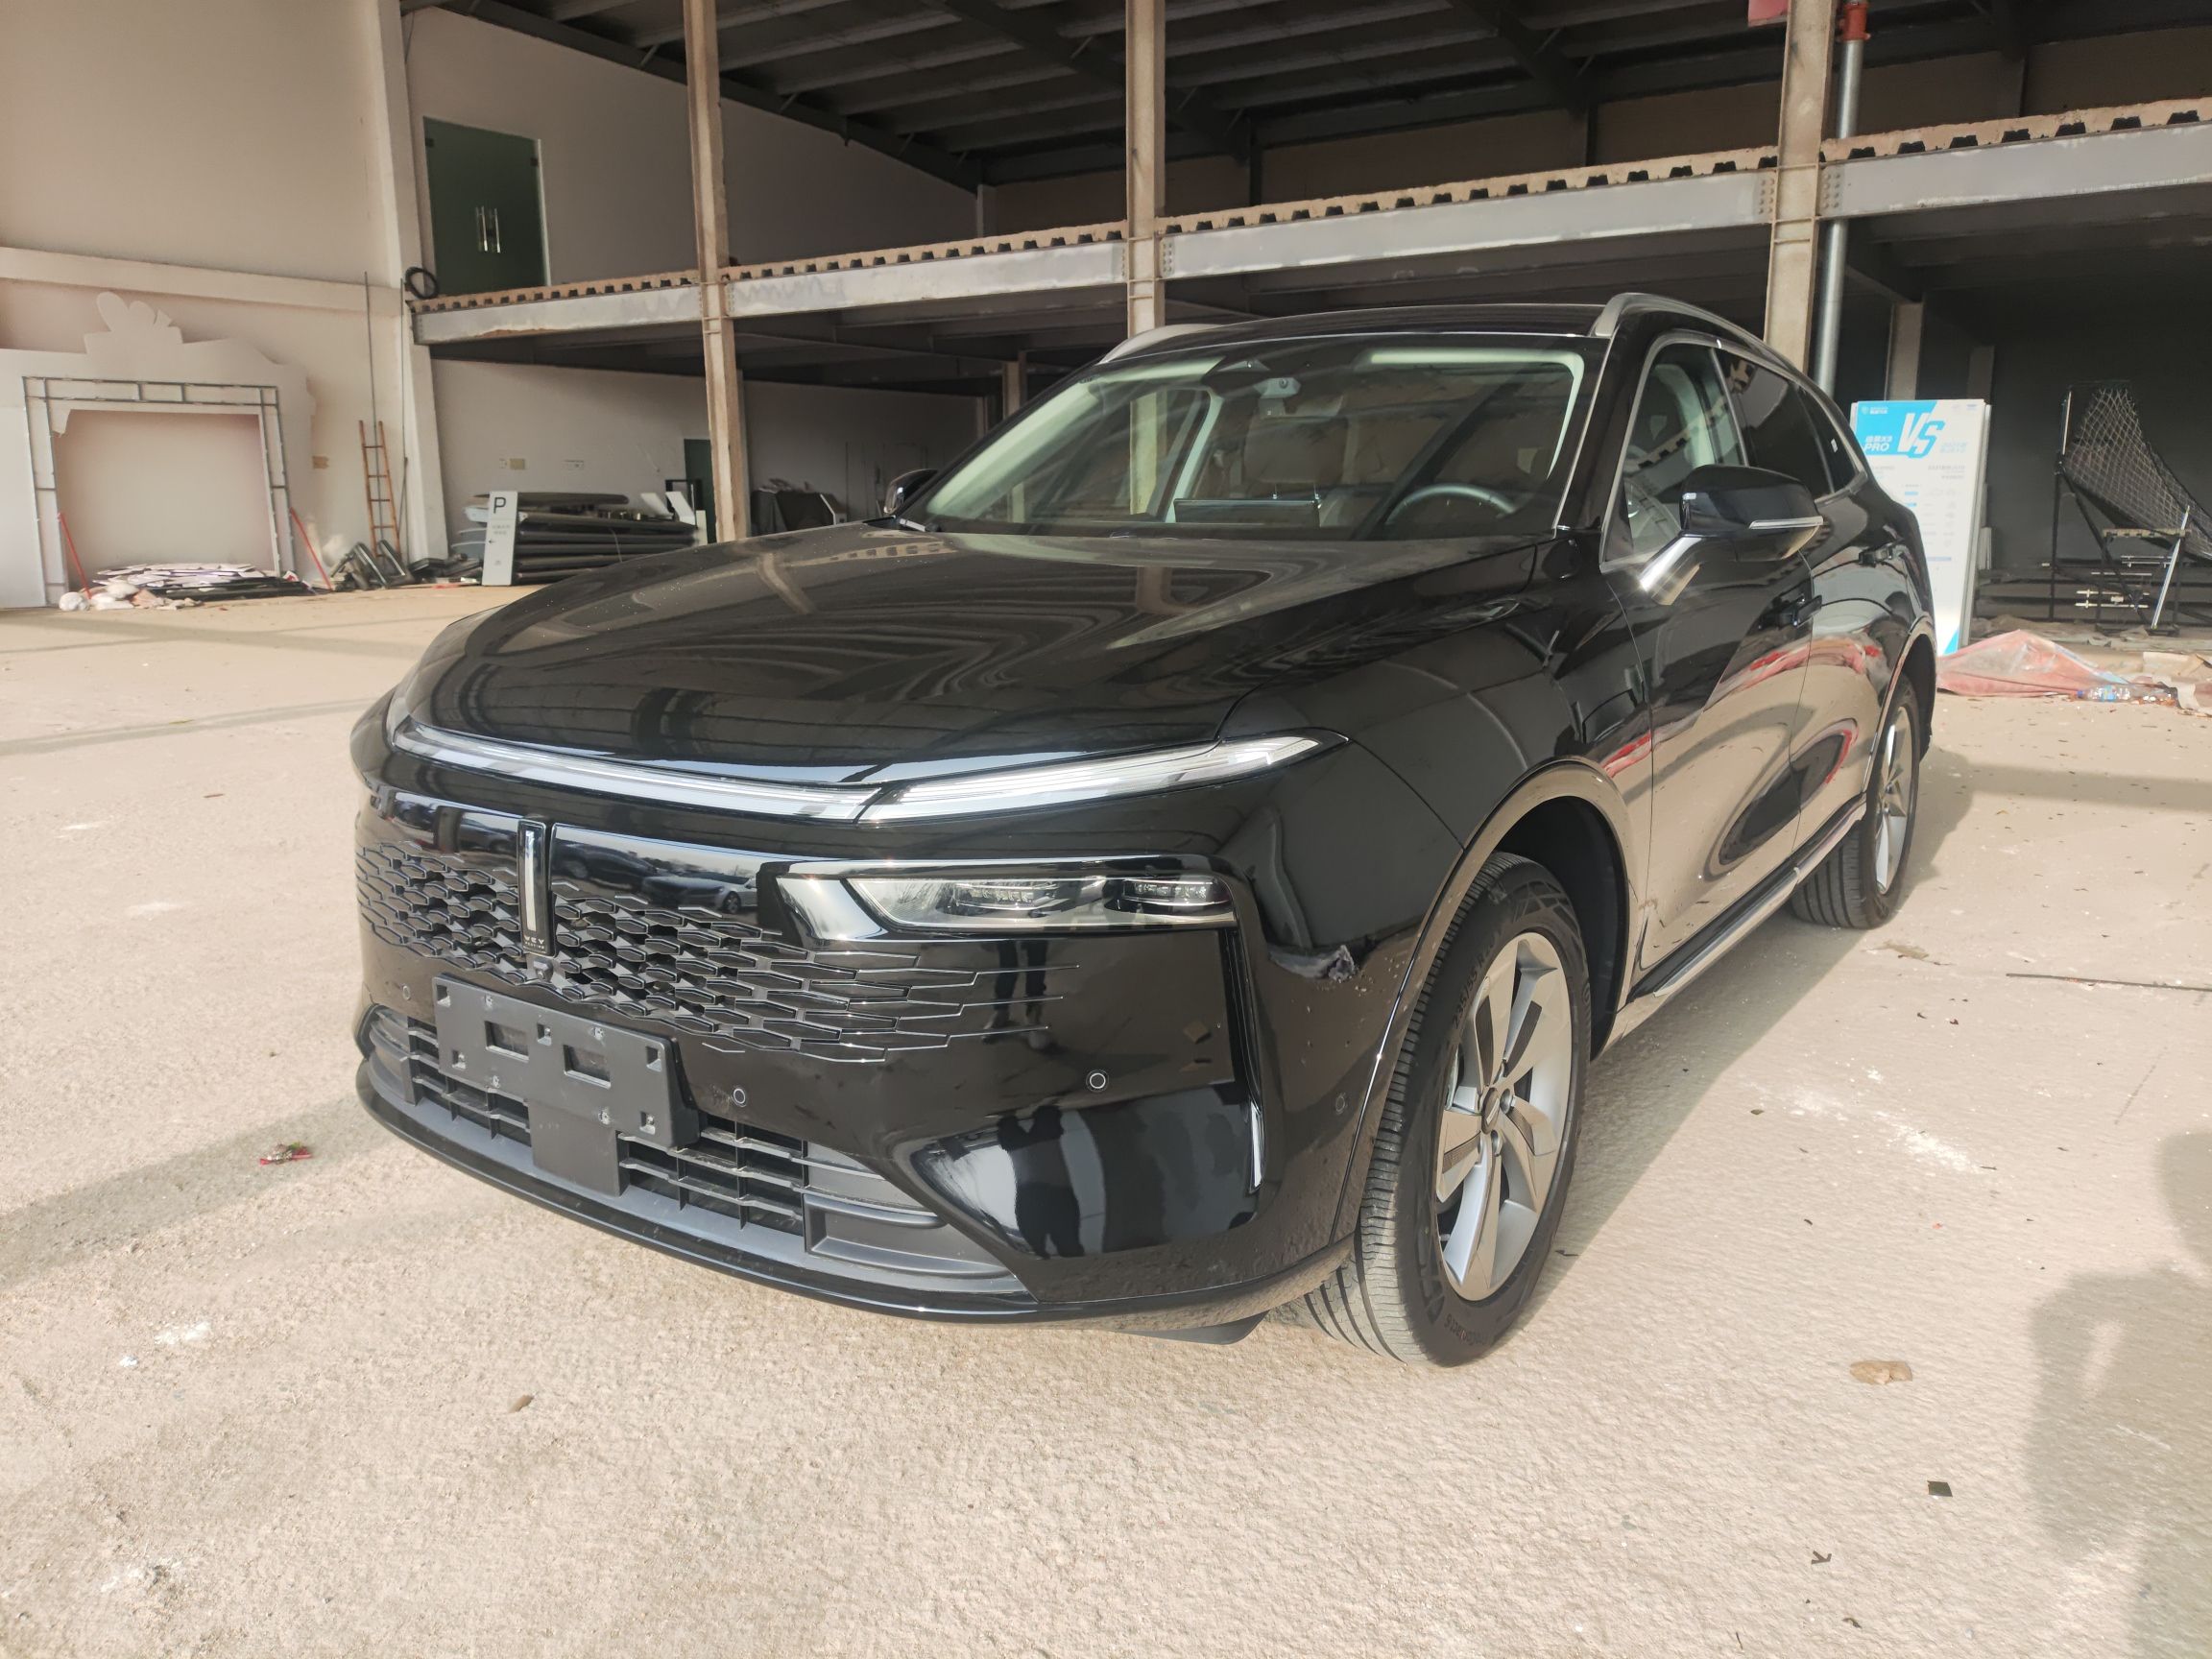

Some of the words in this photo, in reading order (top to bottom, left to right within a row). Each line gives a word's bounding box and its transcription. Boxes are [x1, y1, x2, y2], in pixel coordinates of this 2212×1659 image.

[1897, 413, 1945, 458] VS
[1863, 442, 1890, 452] PRO
[493, 496, 507, 514] P
